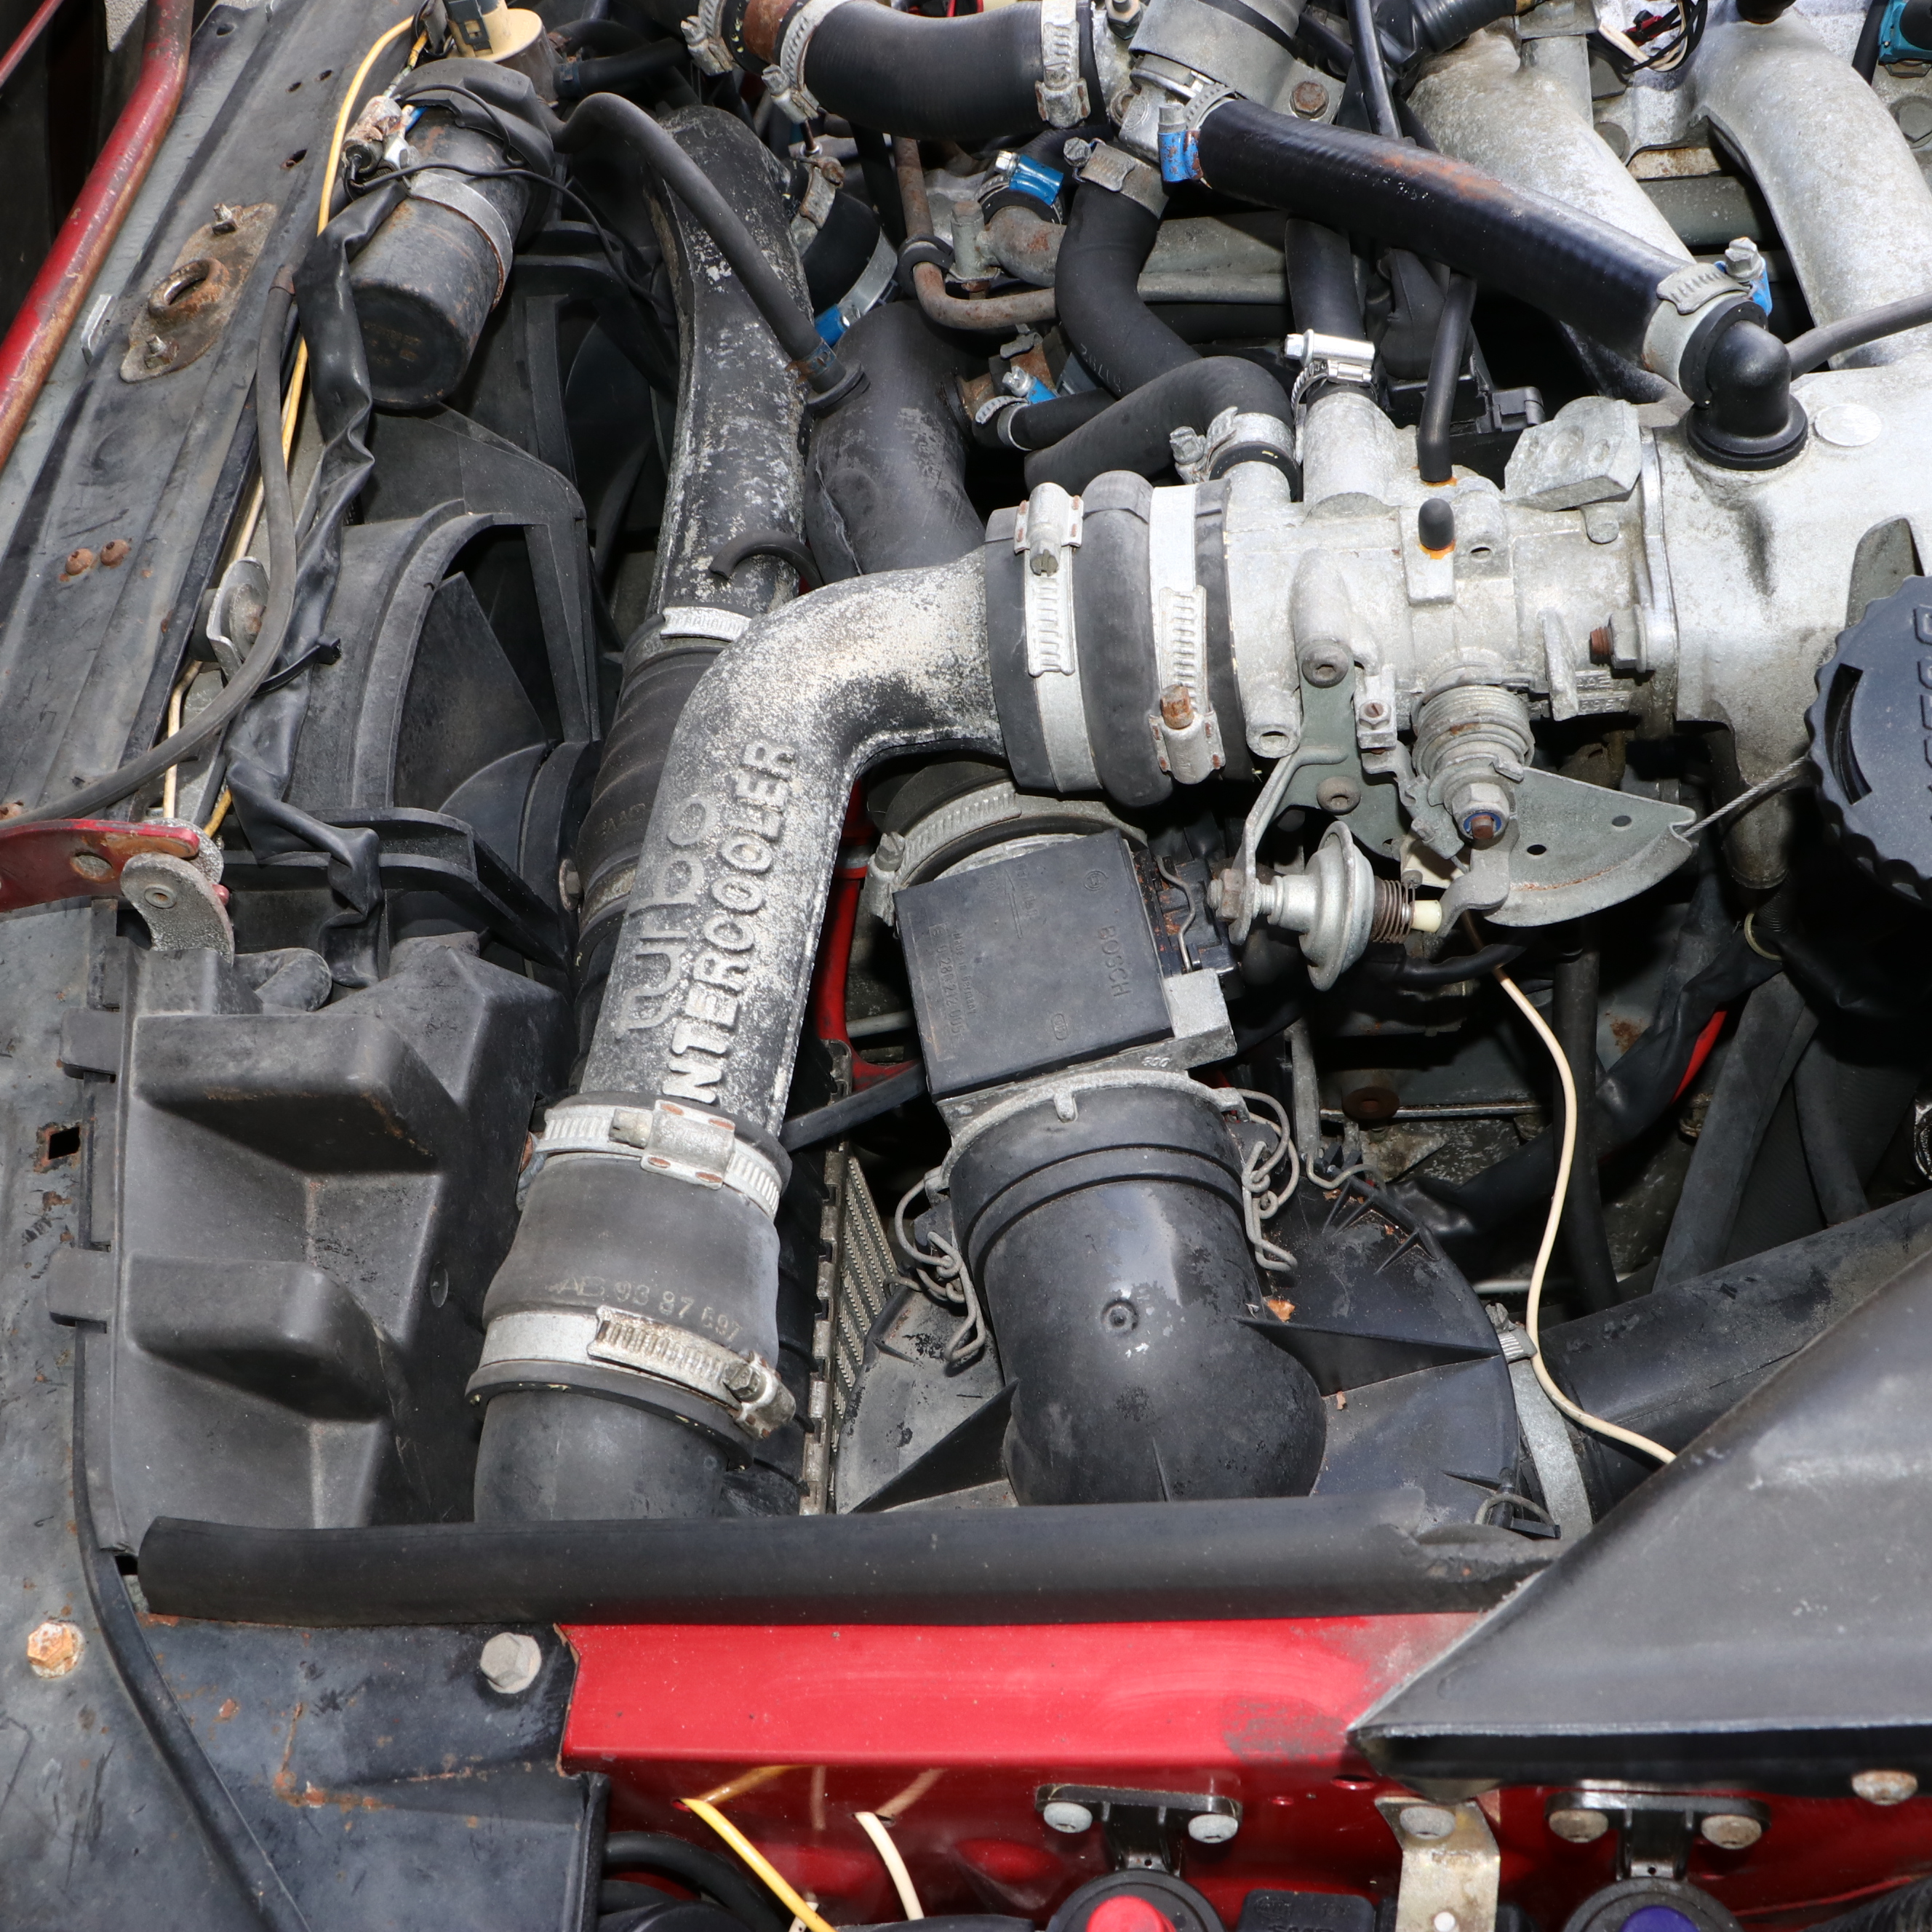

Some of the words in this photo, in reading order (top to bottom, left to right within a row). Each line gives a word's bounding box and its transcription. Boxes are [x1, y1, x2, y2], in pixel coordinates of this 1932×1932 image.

[661, 740, 797, 1104] NTERCOOLER
[1097, 925, 1132, 998] BOSCH
[658, 1290, 695, 1320] 87
